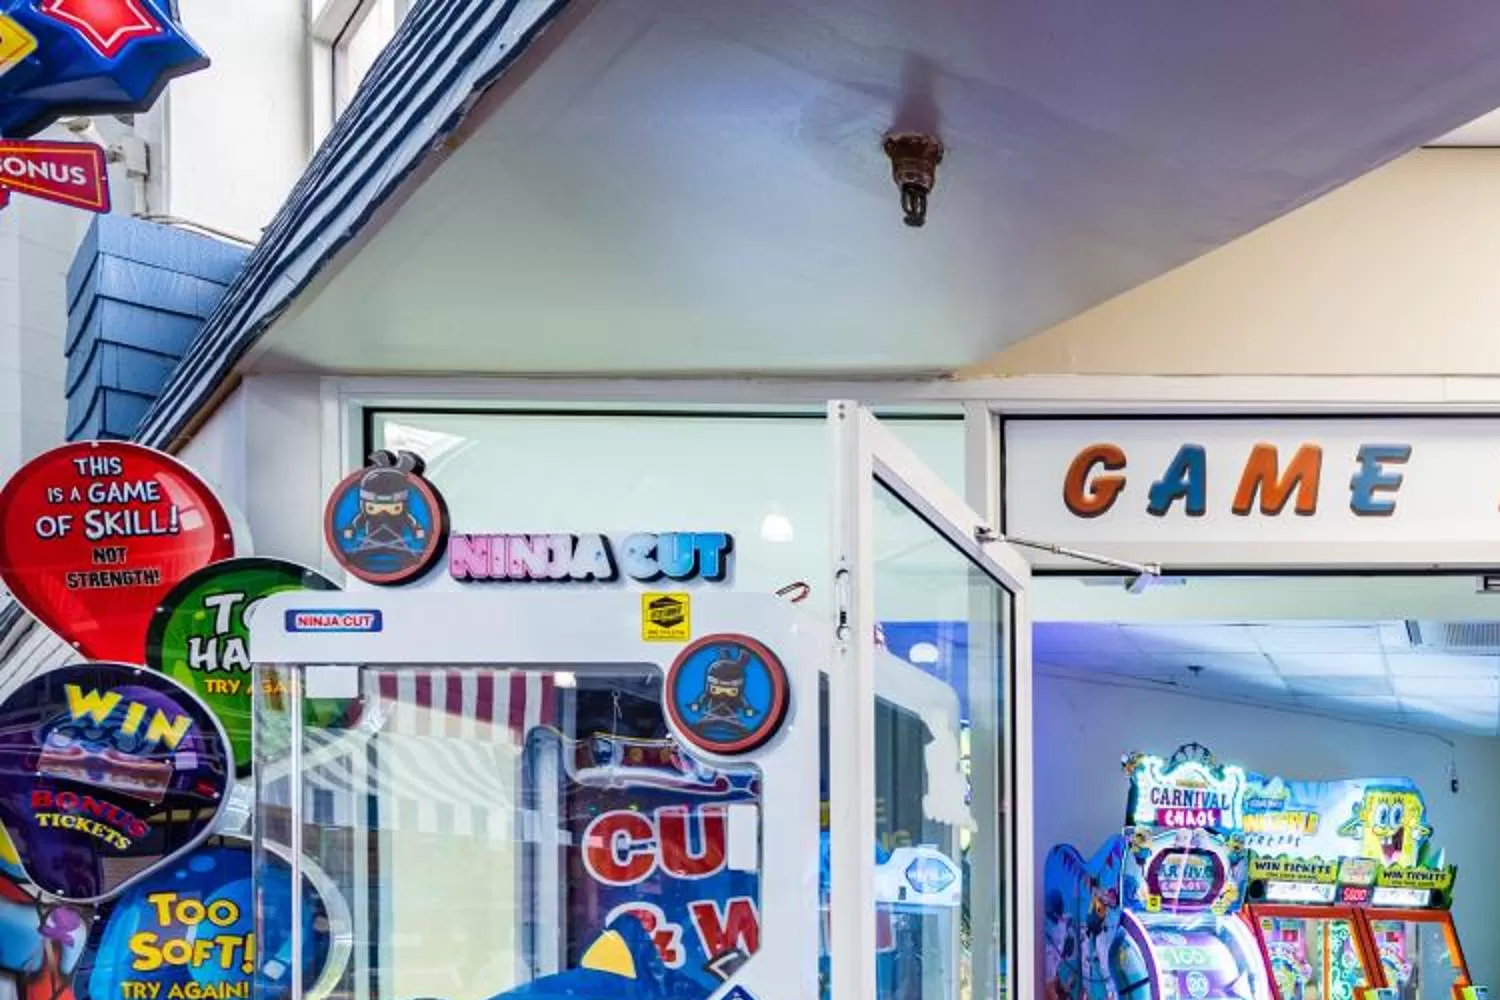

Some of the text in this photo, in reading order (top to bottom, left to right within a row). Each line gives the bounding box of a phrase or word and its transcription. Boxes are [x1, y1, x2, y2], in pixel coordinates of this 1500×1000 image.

[0, 156, 88, 186] ONUS
[73, 456, 123, 477] THIS
[1062, 442, 1412, 518] GAME
[47, 480, 161, 503] IS A GAME
[35, 505, 182, 541] OF SKILL!
[92, 546, 128, 564] NOT
[449, 532, 734, 583] NINJA CUT
[66, 570, 161, 590] STRENGTH!
[296, 614, 374, 628] NINJA CUT
[188, 636, 251, 673] HA
[204, 679, 241, 694] TRY
[63, 683, 193, 749] WIN
[30, 789, 151, 838] BONUS
[1150, 786, 1231, 811] CARNIVAL
[34, 812, 132, 850] TICKETS
[1163, 809, 1217, 827] CHAOS
[584, 806, 728, 886] CU
[1254, 861, 1332, 875] WIN TICKETS
[147, 892, 241, 928] TOO
[128, 932, 257, 975] SOFT!
[121, 981, 250, 1000] TRY AGAIN!
